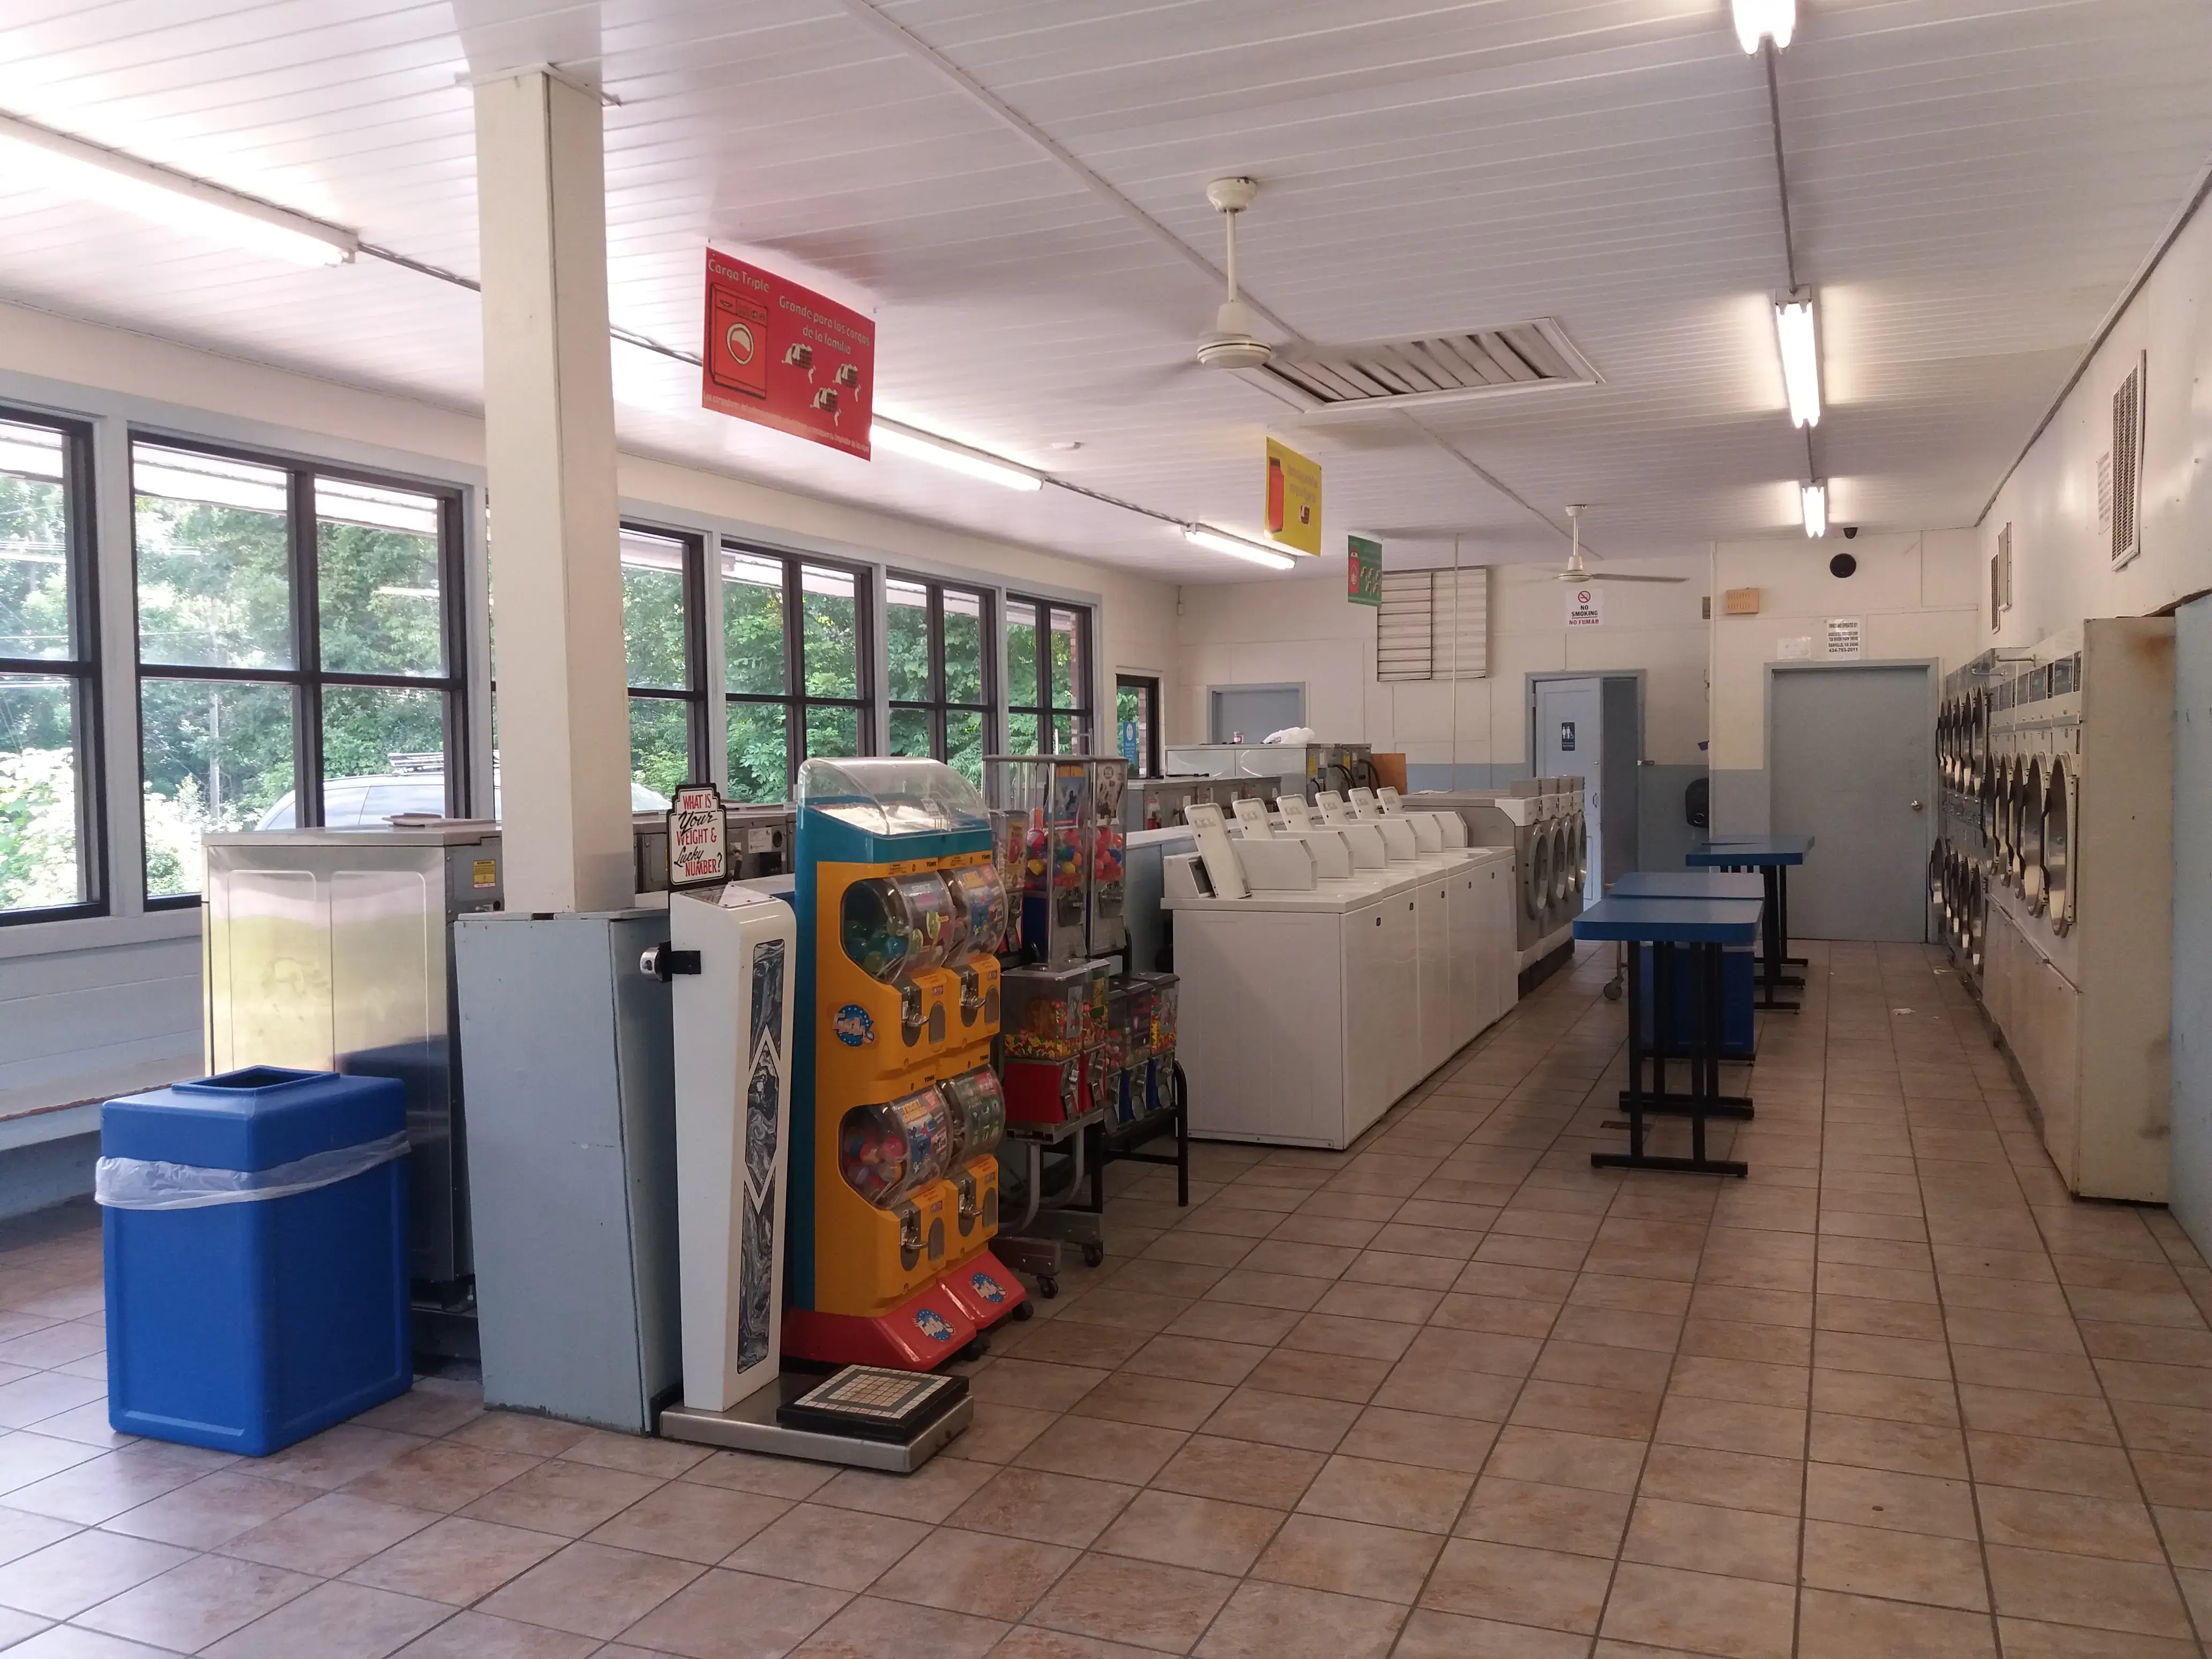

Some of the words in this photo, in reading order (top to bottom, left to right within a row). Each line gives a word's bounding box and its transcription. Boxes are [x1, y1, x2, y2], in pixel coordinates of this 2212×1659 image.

[708, 259, 739, 281] Carga
[741, 271, 769, 293] Triple
[779, 295, 811, 319] Grande
[813, 313, 832, 328] para
[834, 319, 845, 334] las
[846, 327, 870, 346] cargas
[803, 325, 813, 338] de
[815, 329, 823, 342] la
[824, 333, 851, 355] familia
[683, 794, 703, 810] WHAT
[705, 794, 712, 809] IS
[678, 810, 718, 836] Your
[676, 828, 708, 846] WEIGHT
[711, 827, 717, 843] &
[673, 846, 705, 868] Lucky
